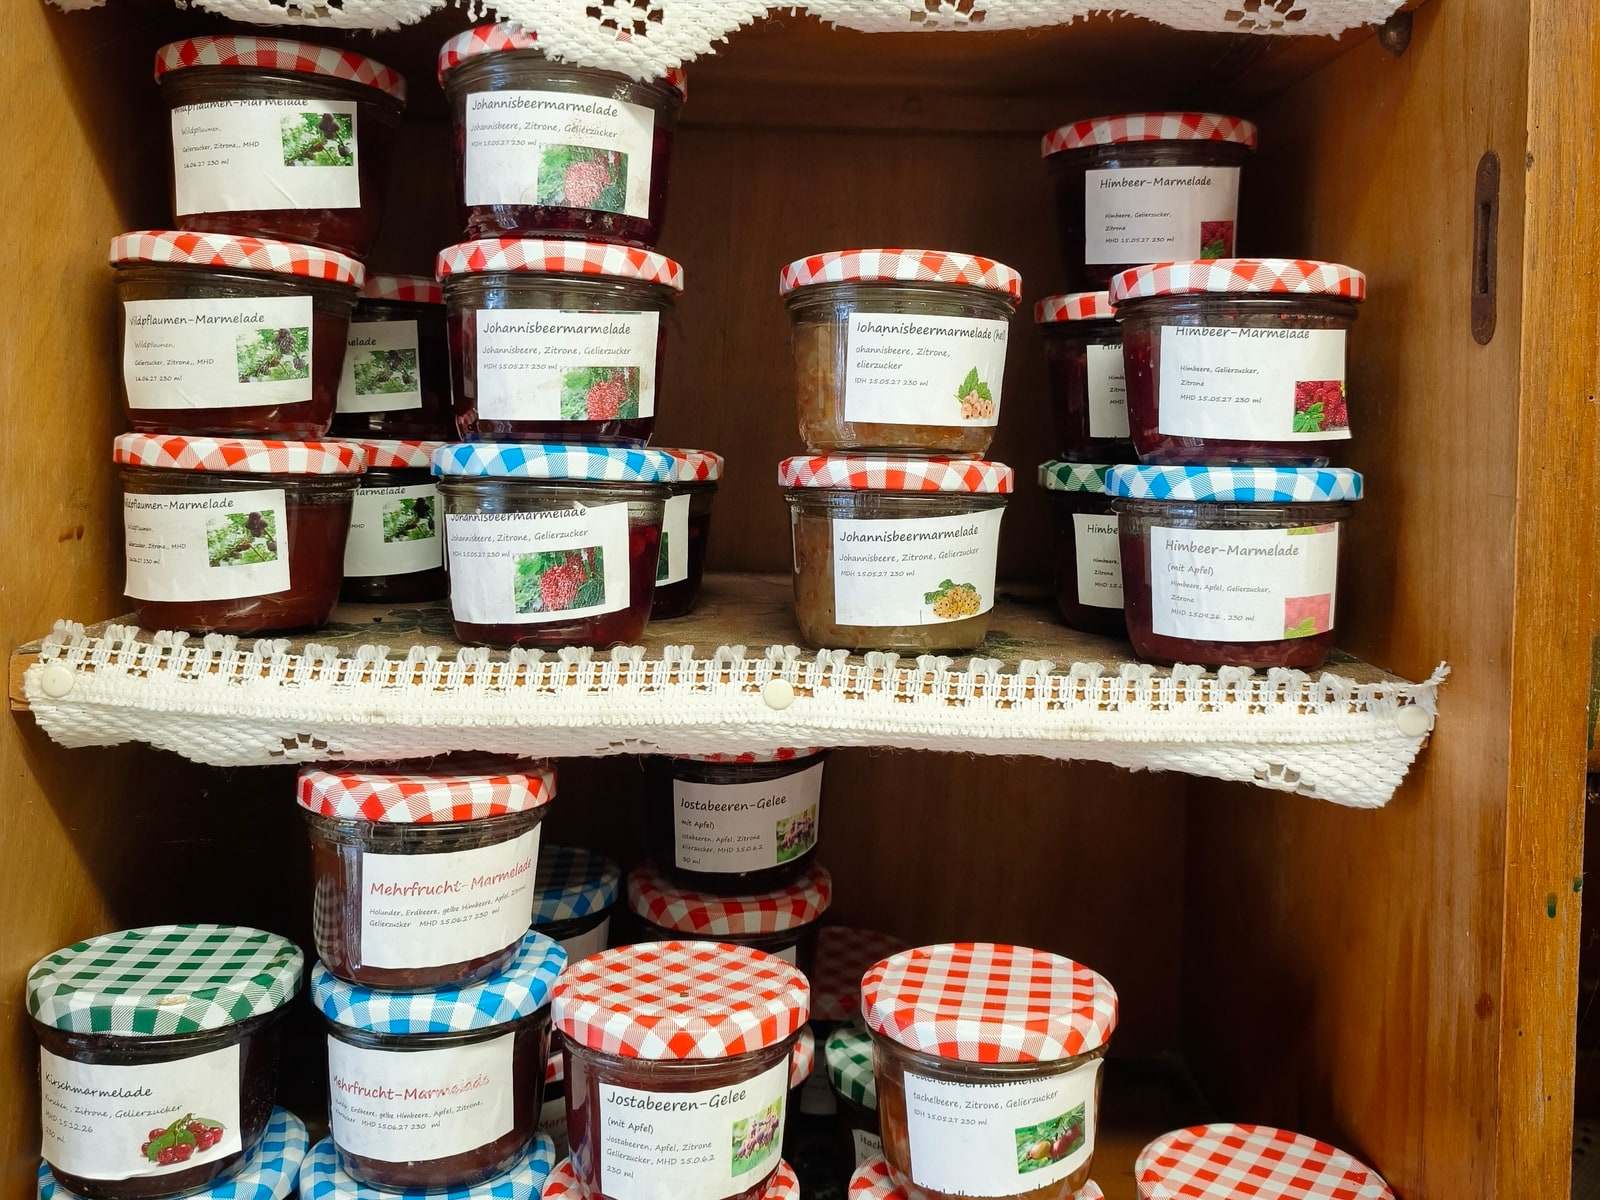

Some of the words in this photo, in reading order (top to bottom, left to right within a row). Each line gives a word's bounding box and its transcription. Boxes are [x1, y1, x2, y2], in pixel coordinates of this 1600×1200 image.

[472, 97, 619, 117] Johannisbeermarmelade
[524, 122, 560, 132] Zitrone,
[1100, 176, 1212, 188] Himbeer-Marmelade
[483, 321, 631, 335] Johannisbeermarmelade
[482, 346, 541, 355] Johannisbeere,
[544, 347, 581, 355] Zitrone,
[584, 347, 631, 355] Gelierzucker
[917, 347, 951, 357] Zitrone,
[497, 534, 531, 542] Zitrone,
[534, 529, 588, 540] Gelierzucker
[840, 524, 978, 542] Johannisbeermarmelade
[1165, 539, 1299, 556] Himbeer-Marmelade
[839, 553, 899, 563] Johannisbeere,
[902, 553, 936, 561] Zitrone,
[1168, 563, 1185, 573] (mit
[1187, 564, 1214, 576] Apfel)
[694, 821, 715, 830] Apfel)
[474, 911, 488, 920] 230
[45, 1071, 153, 1099] Kirschmarmelade
[607, 1089, 747, 1112] Jostabeeren-Gelee
[965, 1101, 1003, 1110] Zitrone,
[1005, 1090, 1059, 1108] Gelierzucker
[115, 1104, 183, 1119] Gelierzucker
[607, 1117, 625, 1128] (mit
[628, 1122, 654, 1135] Apfel)
[960, 1117, 976, 1125] 230
[606, 1135, 651, 1151] Jostabeeren,
[655, 1144, 679, 1153] Apfel,
[682, 1142, 712, 1152] Zitrone
[656, 1158, 677, 1166] MHD
[606, 1166, 621, 1175] 230
[623, 1170, 634, 1178] ml
